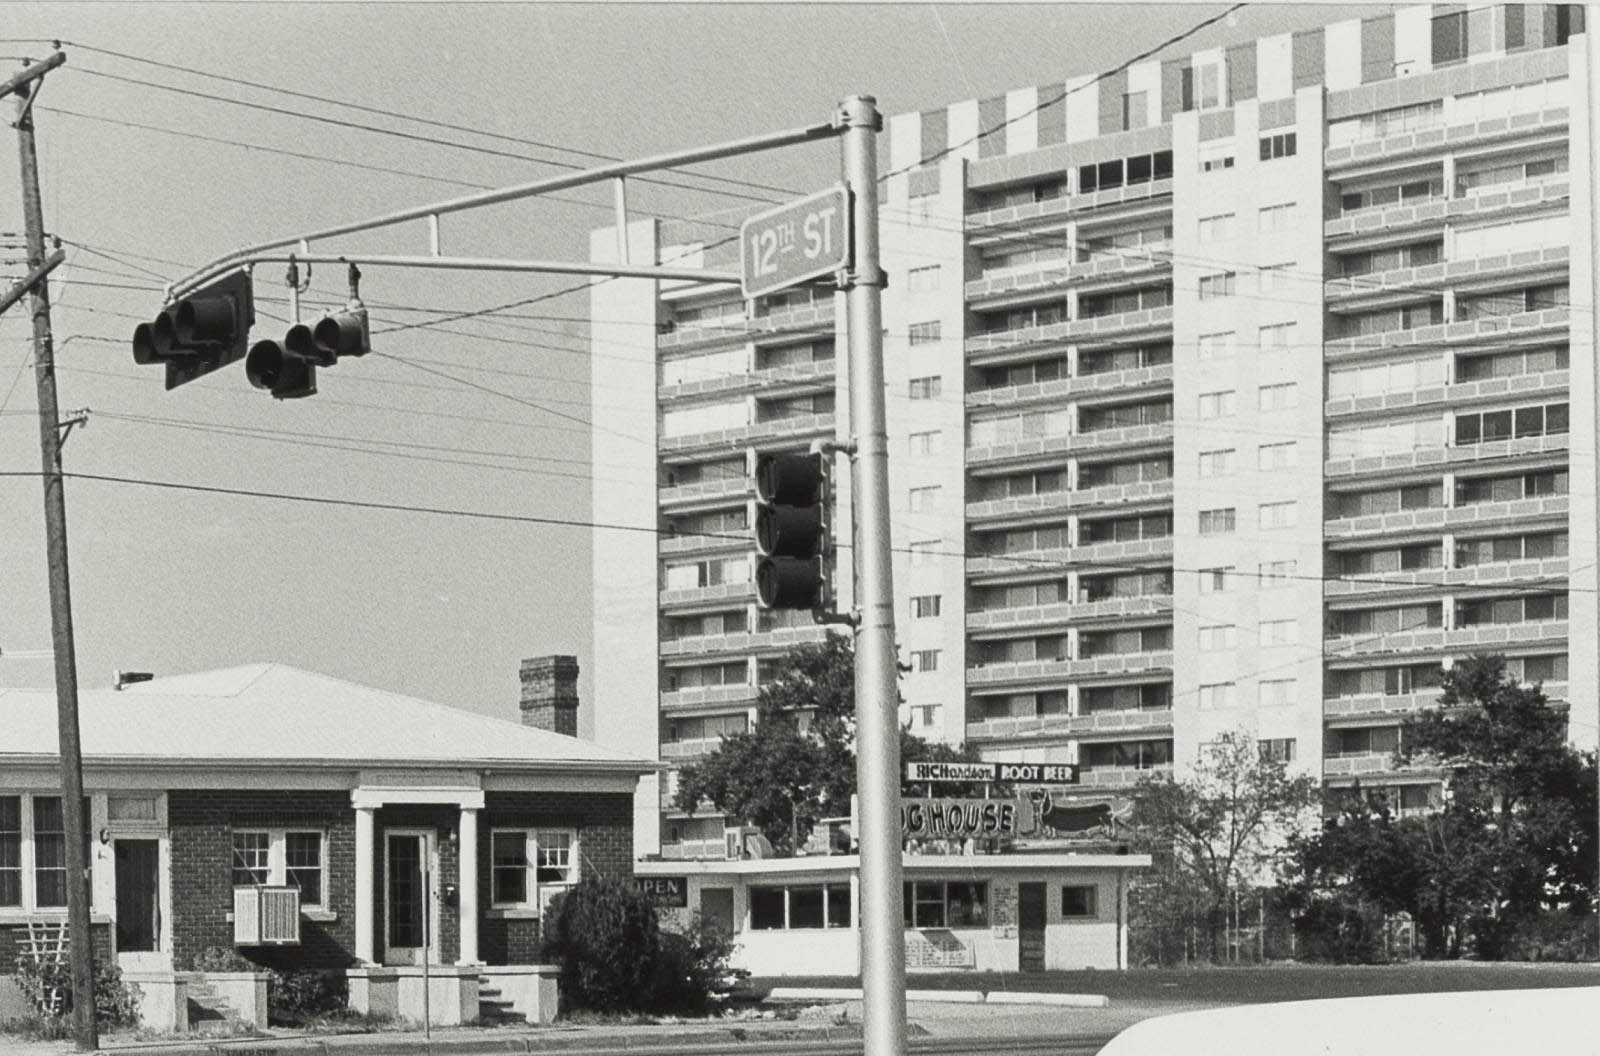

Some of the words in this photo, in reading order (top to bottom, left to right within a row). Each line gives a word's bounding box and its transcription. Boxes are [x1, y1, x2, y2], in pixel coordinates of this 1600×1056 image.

[750, 220, 795, 278] 12TH
[803, 206, 836, 259] ST
[1001, 766, 1040, 780] ROOT
[1043, 766, 1073, 781] BEER
[928, 803, 1016, 833] HOUSE
